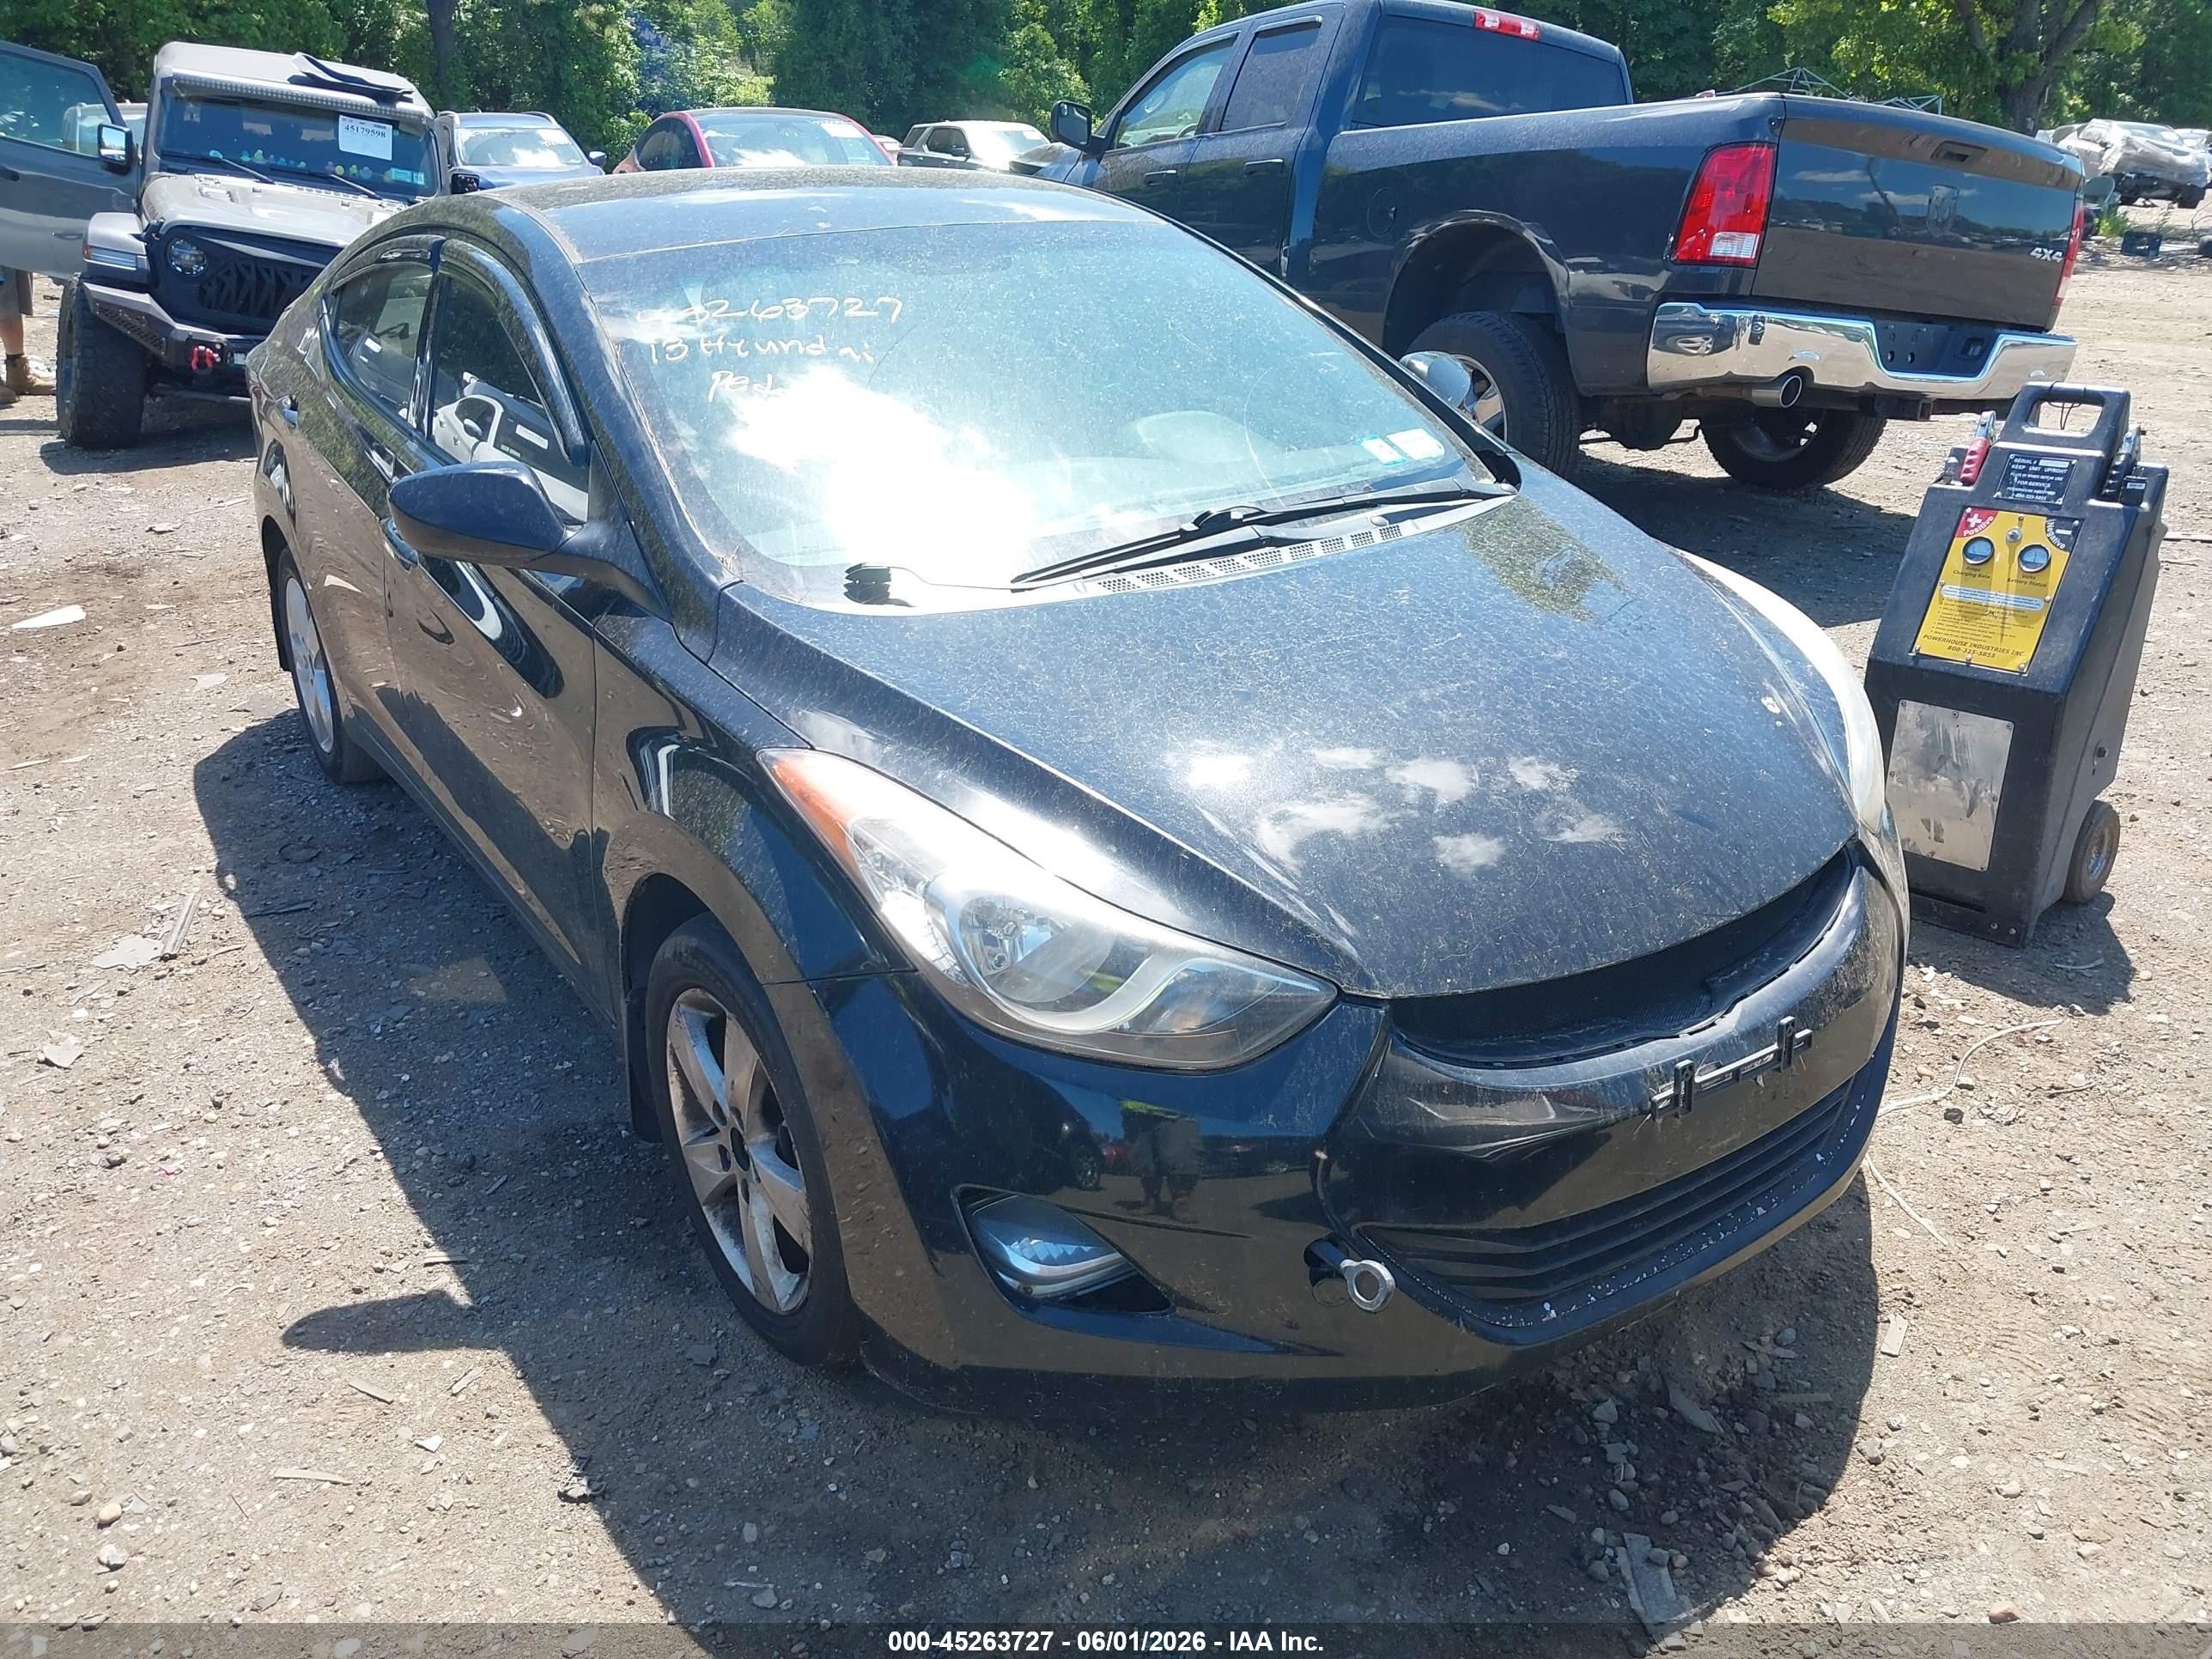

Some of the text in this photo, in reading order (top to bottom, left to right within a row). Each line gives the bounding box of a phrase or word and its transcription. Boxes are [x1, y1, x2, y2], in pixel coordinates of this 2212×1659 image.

[344, 124, 386, 138] 45179598
[650, 336, 689, 364] 13
[1963, 515, 1994, 537] Positive
[2046, 519, 2066, 550] Negative
[1953, 569, 1978, 578] Charging
[1923, 634, 1968, 647] POWERHOUSE
[1968, 642, 2010, 654] INDUSTRIES
[1947, 645, 1996, 659] 800-325-5855
